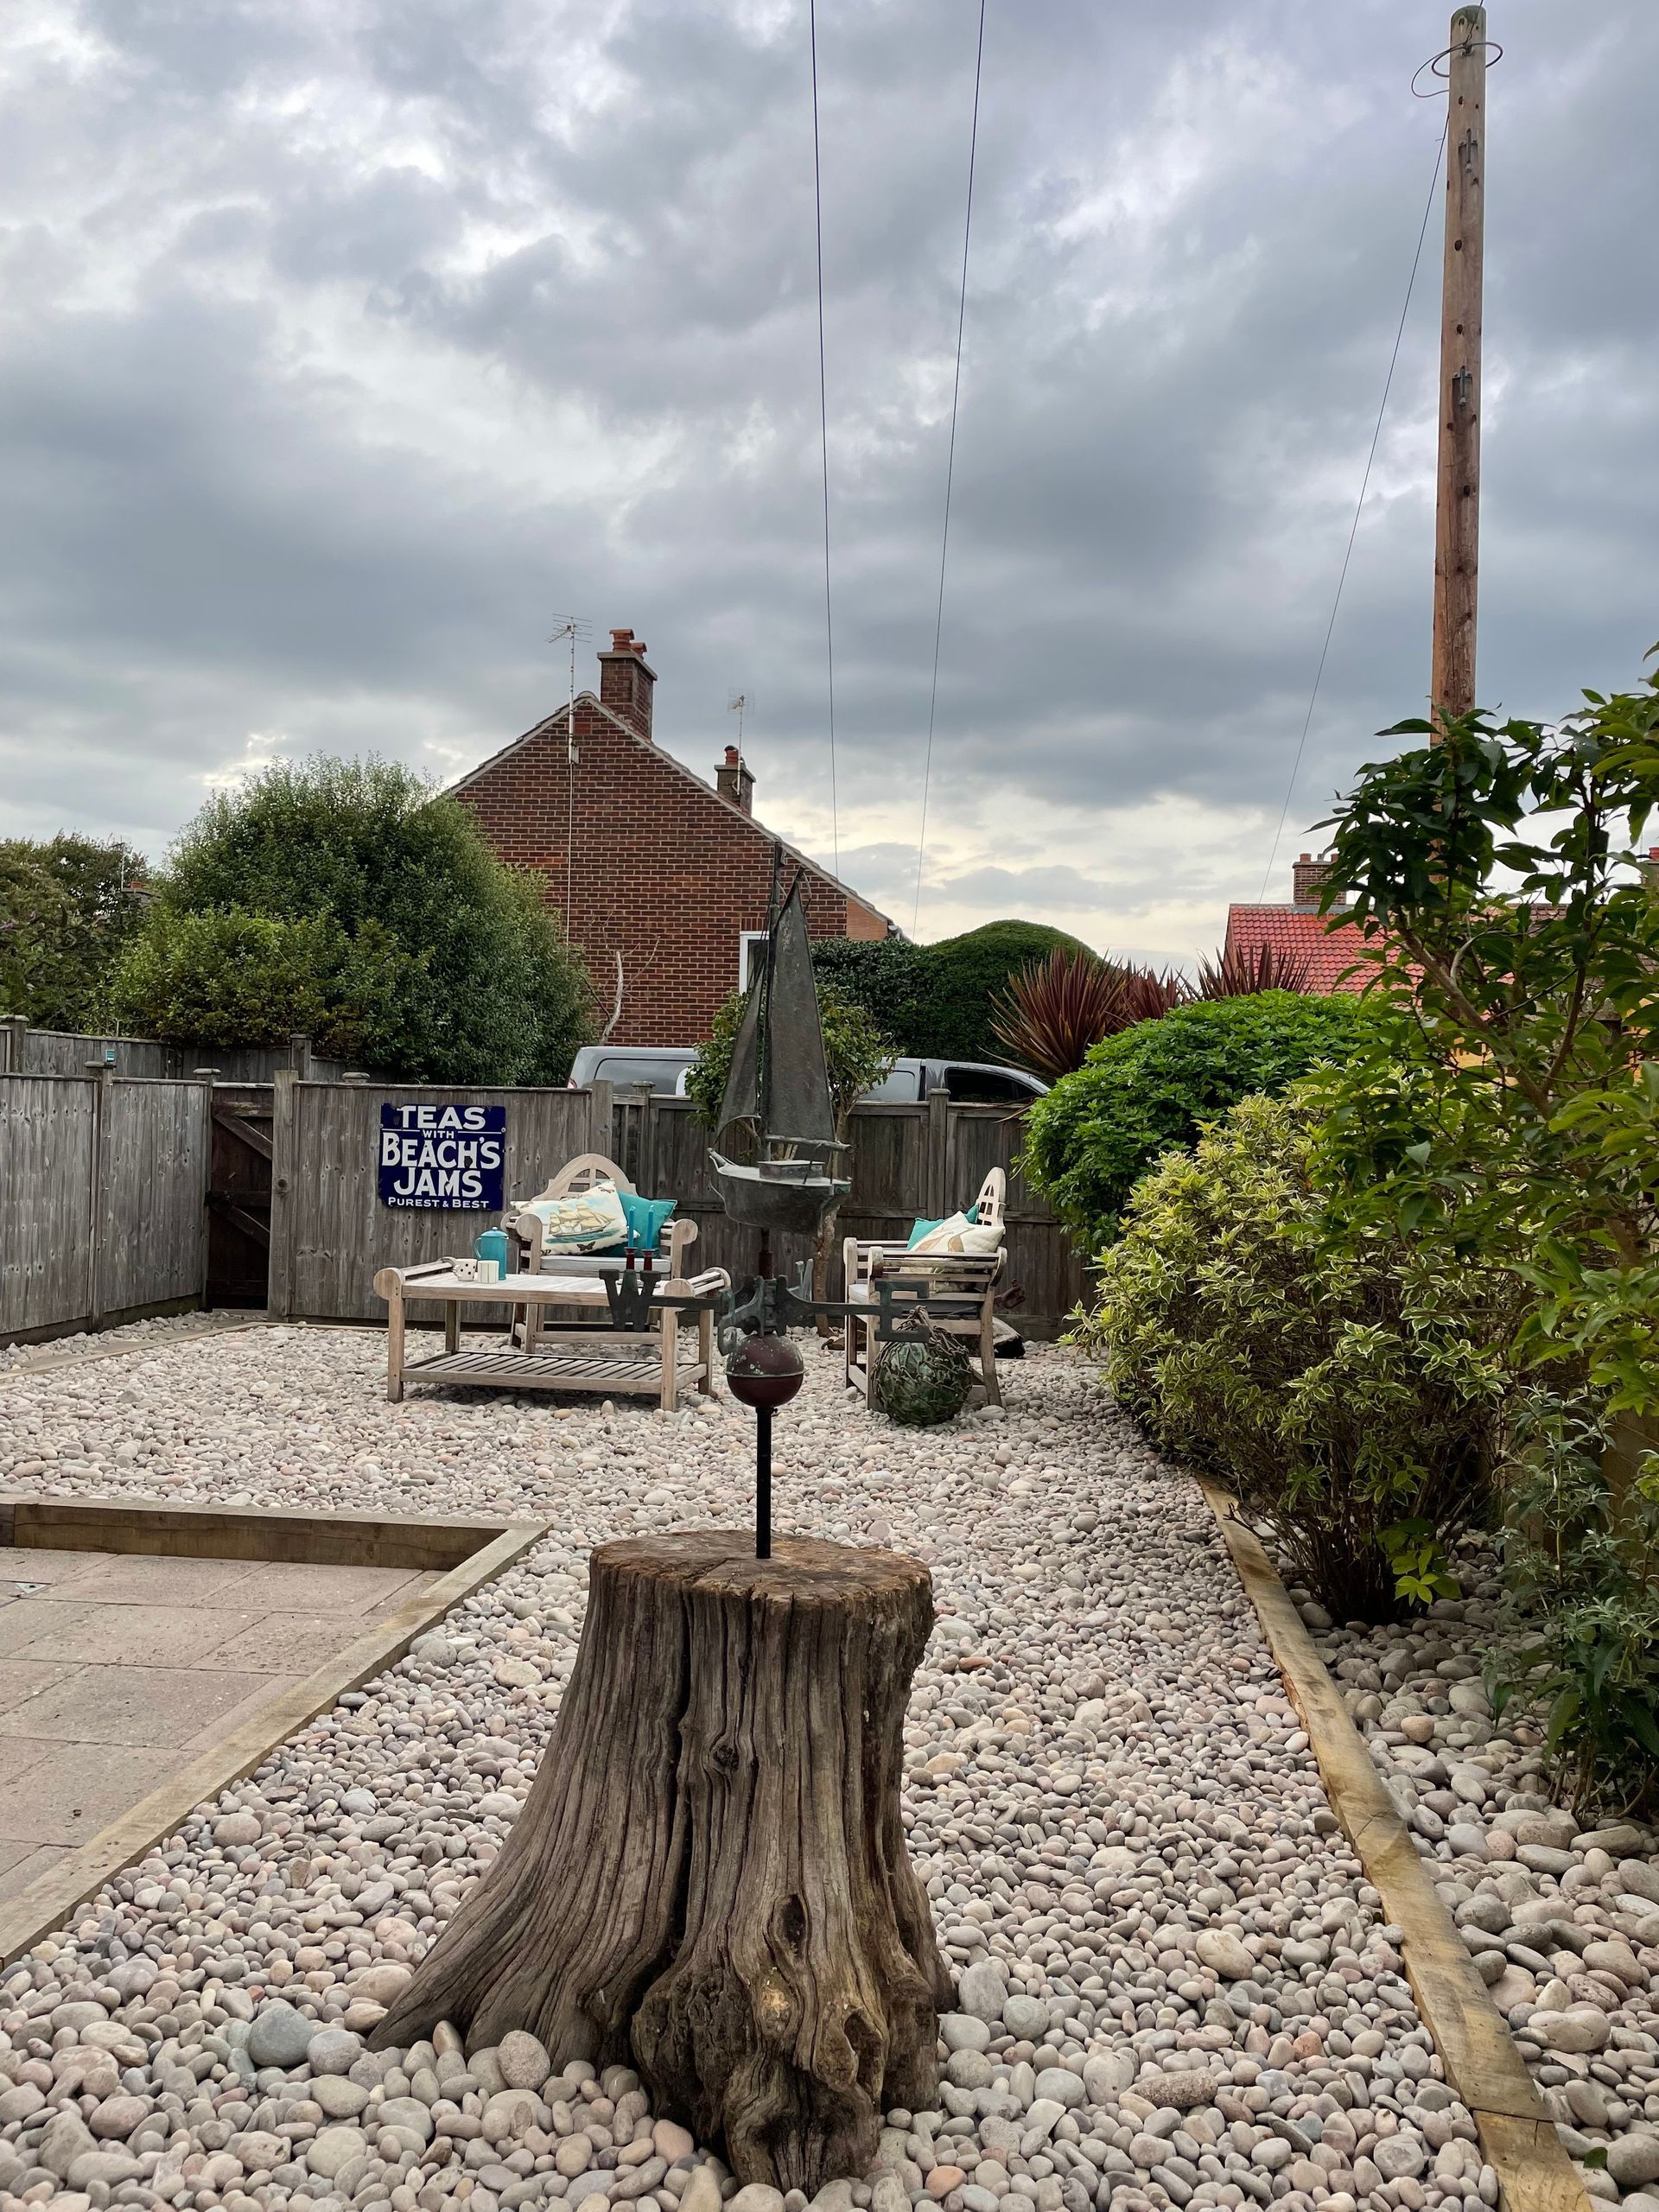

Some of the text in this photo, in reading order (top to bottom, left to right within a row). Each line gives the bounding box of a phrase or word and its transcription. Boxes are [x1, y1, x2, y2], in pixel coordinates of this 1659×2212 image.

[397, 1105, 486, 1130] TEAS
[423, 1129, 454, 1139] WITH
[381, 1132, 501, 1170] BEACH'S
[393, 1167, 483, 1198] JAMS
[599, 1268, 661, 1332] W
[874, 1280, 930, 1343] E
